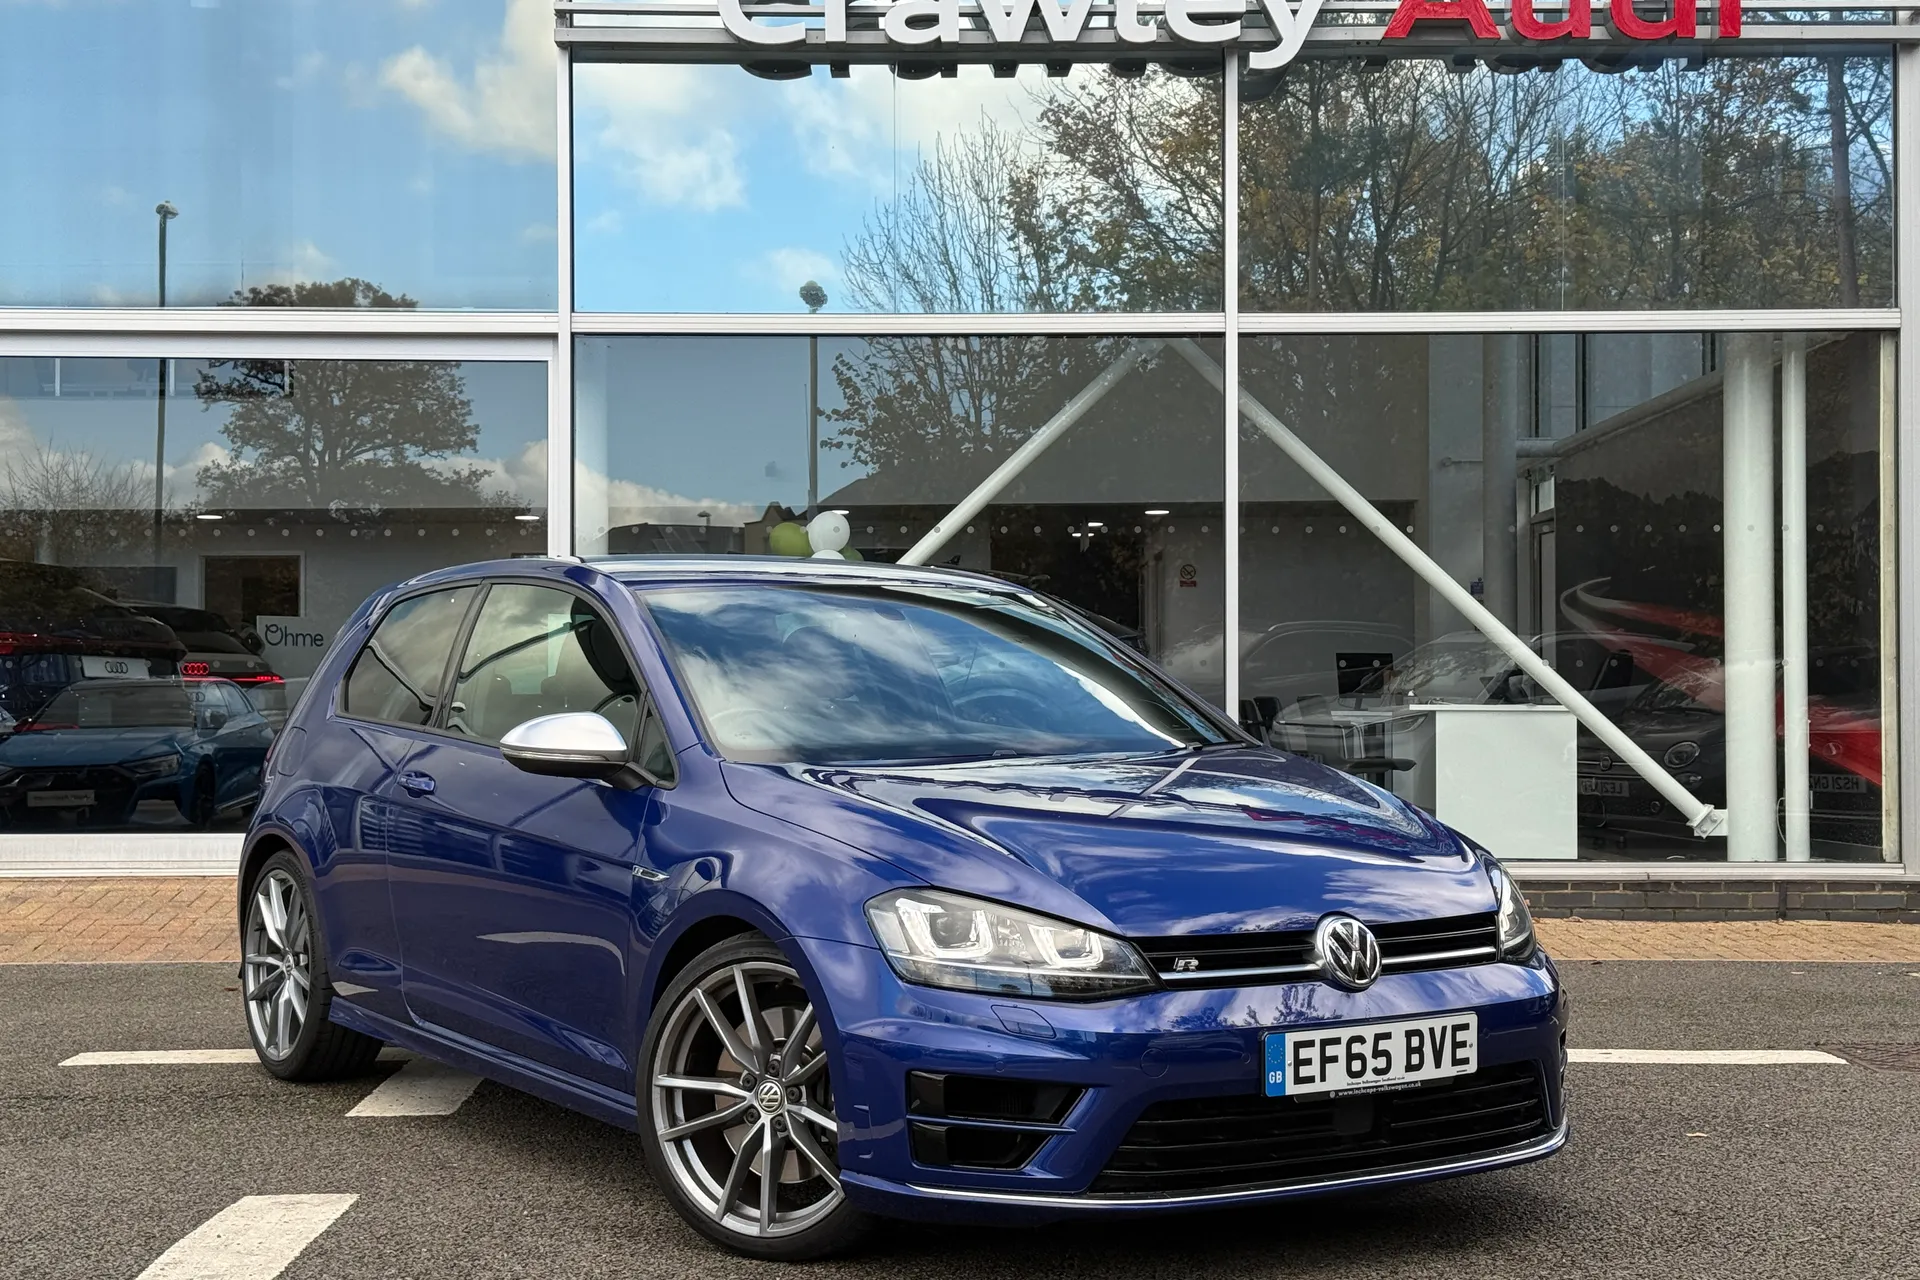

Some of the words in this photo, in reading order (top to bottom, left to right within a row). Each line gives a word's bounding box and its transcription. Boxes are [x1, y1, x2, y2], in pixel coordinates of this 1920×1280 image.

[265, 624, 323, 647] Ohme
[1293, 1031, 1393, 1086] EF65
[1404, 1022, 1471, 1073] BVE
[1268, 1071, 1283, 1084] GB
